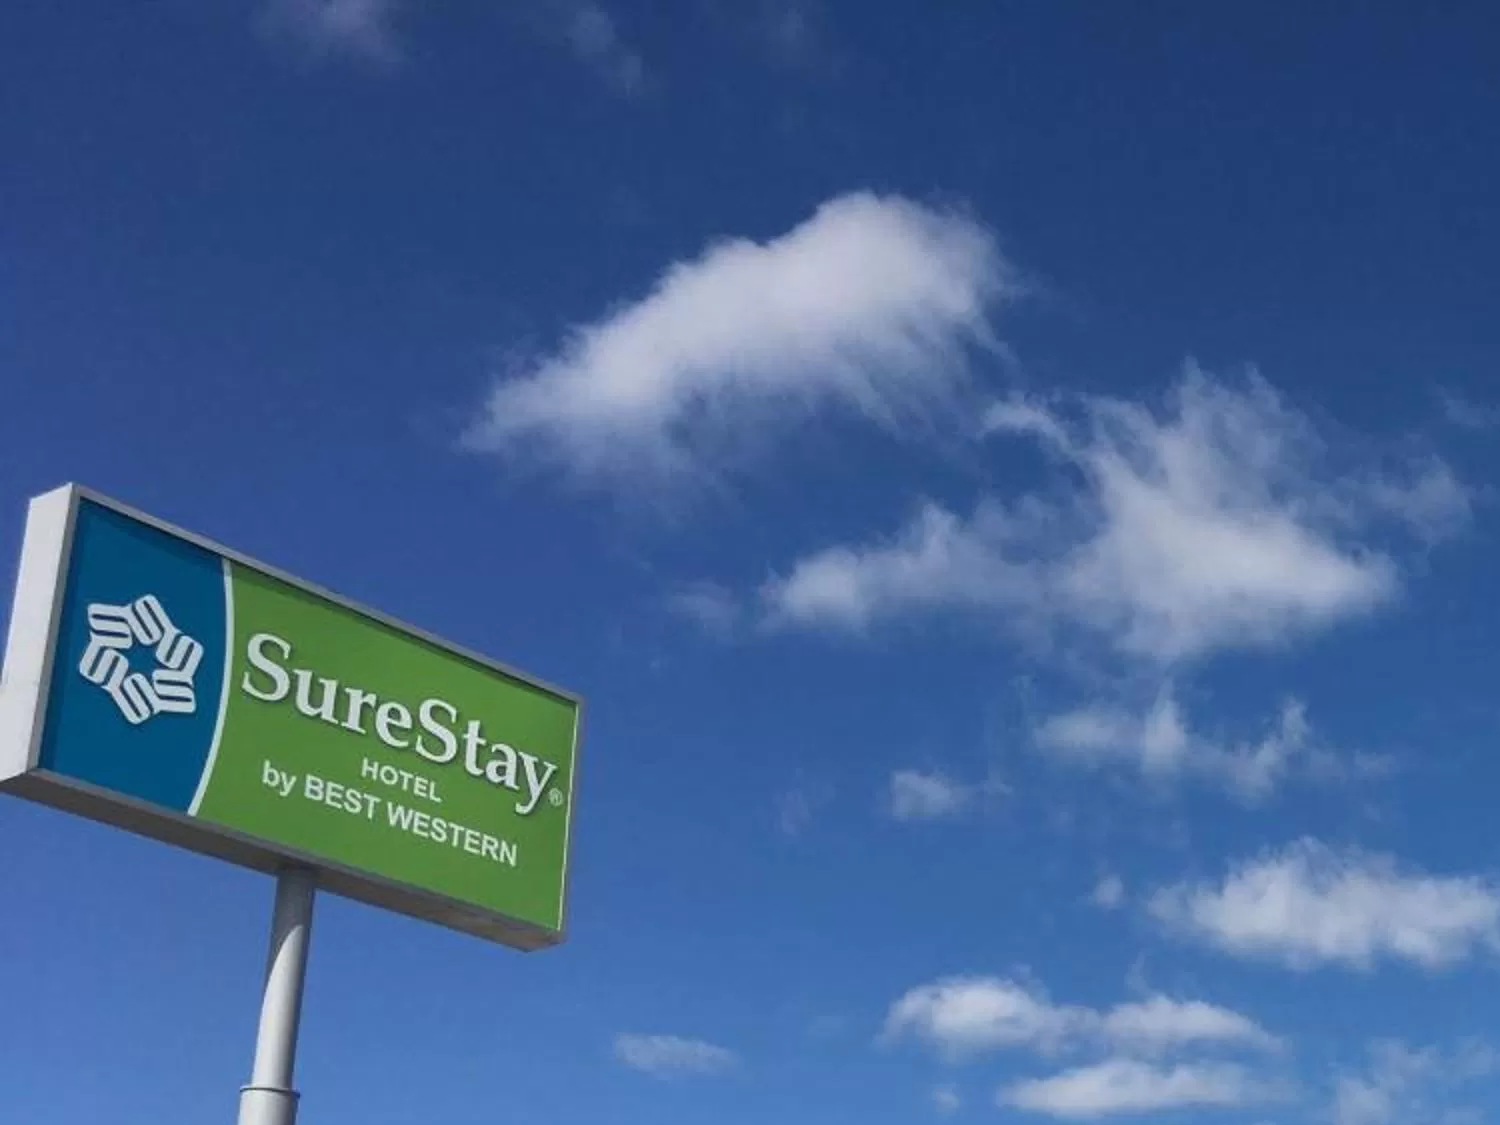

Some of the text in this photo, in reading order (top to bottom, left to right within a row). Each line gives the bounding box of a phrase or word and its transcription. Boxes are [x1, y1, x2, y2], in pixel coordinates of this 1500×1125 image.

[242, 633, 557, 814] SureStay
[262, 759, 517, 867] by BEST WESTERN
[361, 757, 442, 803] HOTEL
